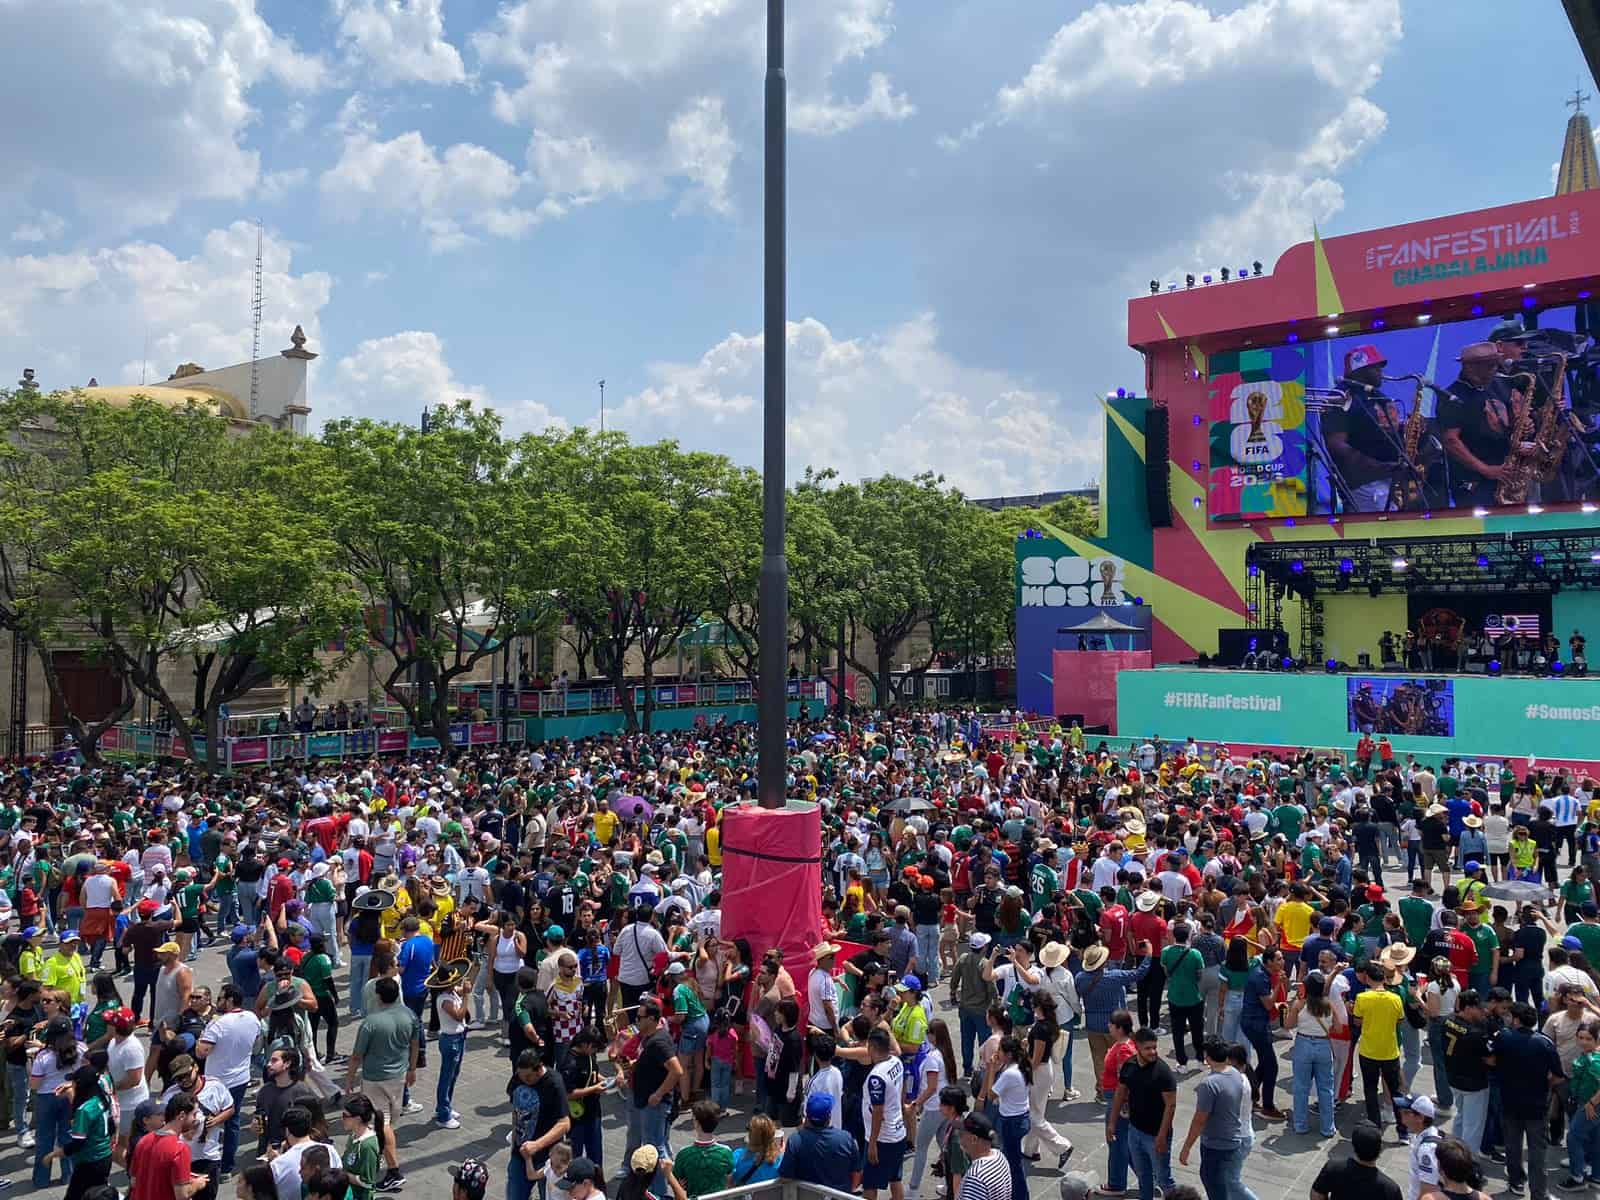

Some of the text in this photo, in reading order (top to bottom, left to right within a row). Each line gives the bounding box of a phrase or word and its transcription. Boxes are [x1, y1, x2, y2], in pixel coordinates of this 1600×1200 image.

[1392, 246, 1549, 287] GUADALAJARA
[1245, 445, 1270, 456] FIFA
[1231, 463, 1285, 475] WOD CUP
[1163, 691, 1282, 712] #FIFAFanFestival
[561, 893, 574, 915] 18
[1445, 1031, 1457, 1057] 7
